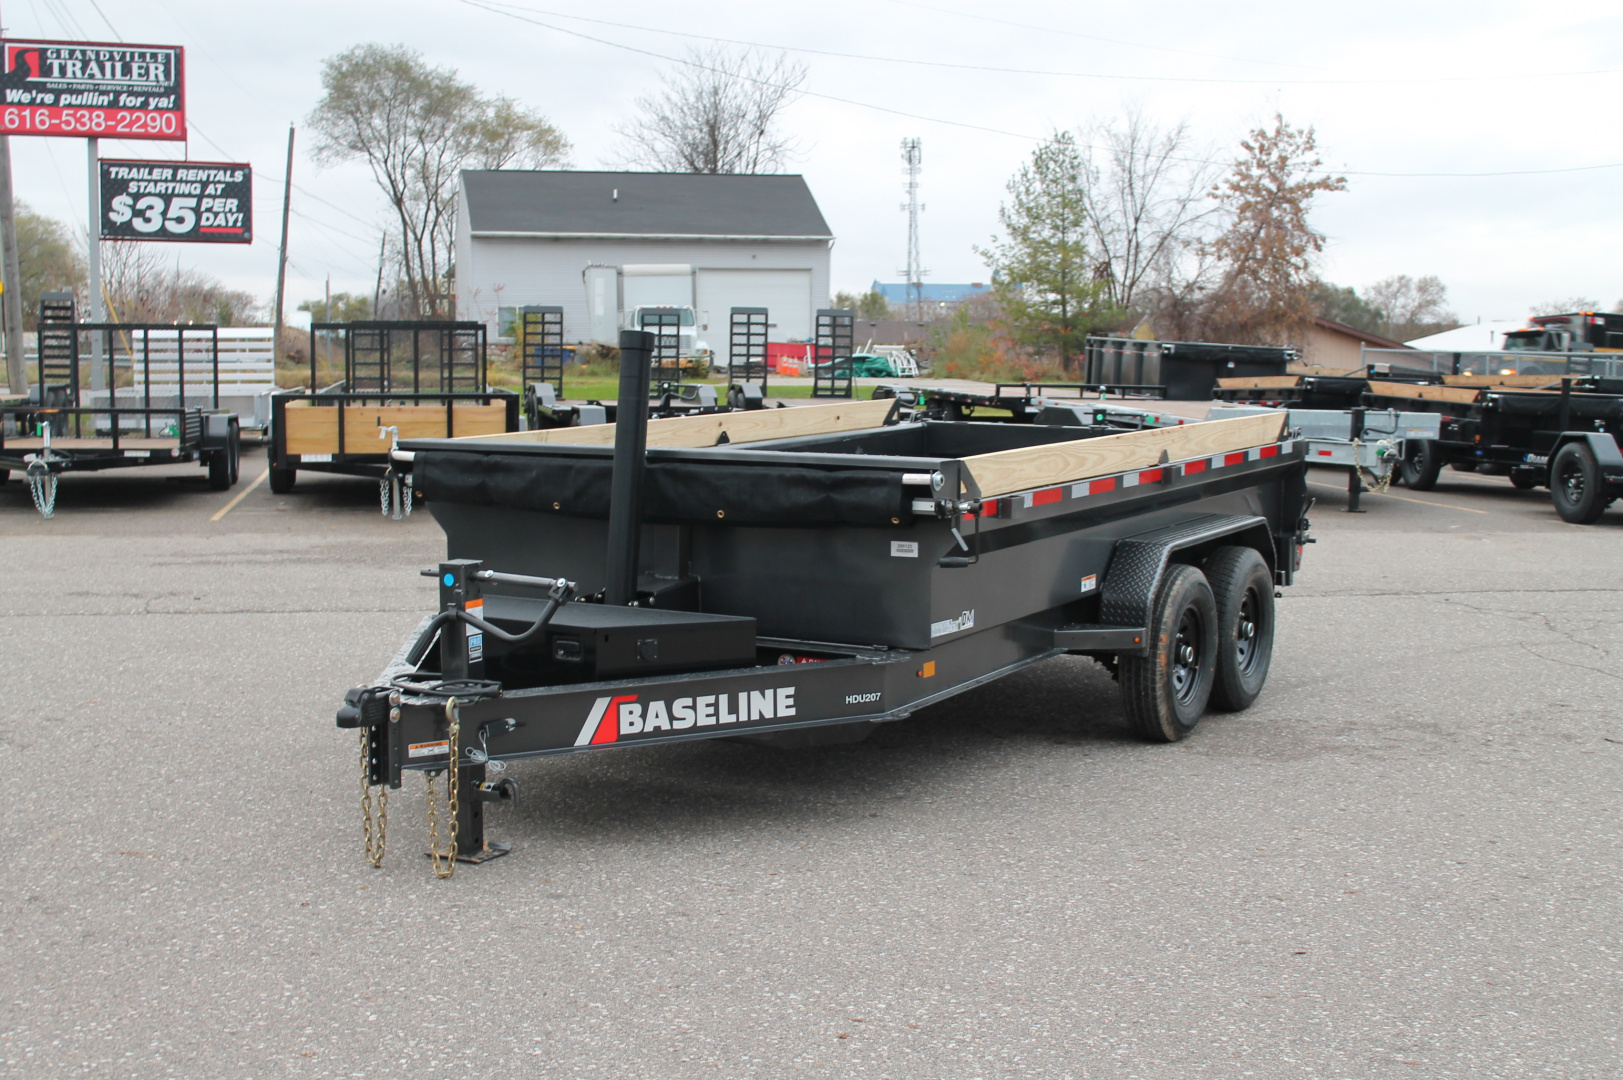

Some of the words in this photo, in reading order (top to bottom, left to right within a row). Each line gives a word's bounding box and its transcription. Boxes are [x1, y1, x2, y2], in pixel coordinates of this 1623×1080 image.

[47, 49, 166, 63] GRANDVILLE
[47, 59, 166, 82] TRAILER
[46, 82, 68, 90] SALES
[72, 83, 94, 91] PARTS
[99, 84, 128, 92] SERVICE
[133, 85, 165, 93] RENTALS
[5, 89, 55, 104] We're
[59, 90, 113, 107] pullin'
[119, 93, 146, 108] for
[148, 94, 175, 110] ya!
[4, 108, 176, 133] 616-538-2290
[109, 167, 173, 180] TRAILER
[176, 169, 244, 182] RENTALS
[128, 181, 201, 195] STARTING
[204, 183, 226, 196] AT
[201, 198, 239, 212] PER
[108, 192, 198, 234] $35
[200, 213, 244, 227] DAY!
[845, 692, 882, 705] HDU207
[619, 686, 797, 736] BASELINE
